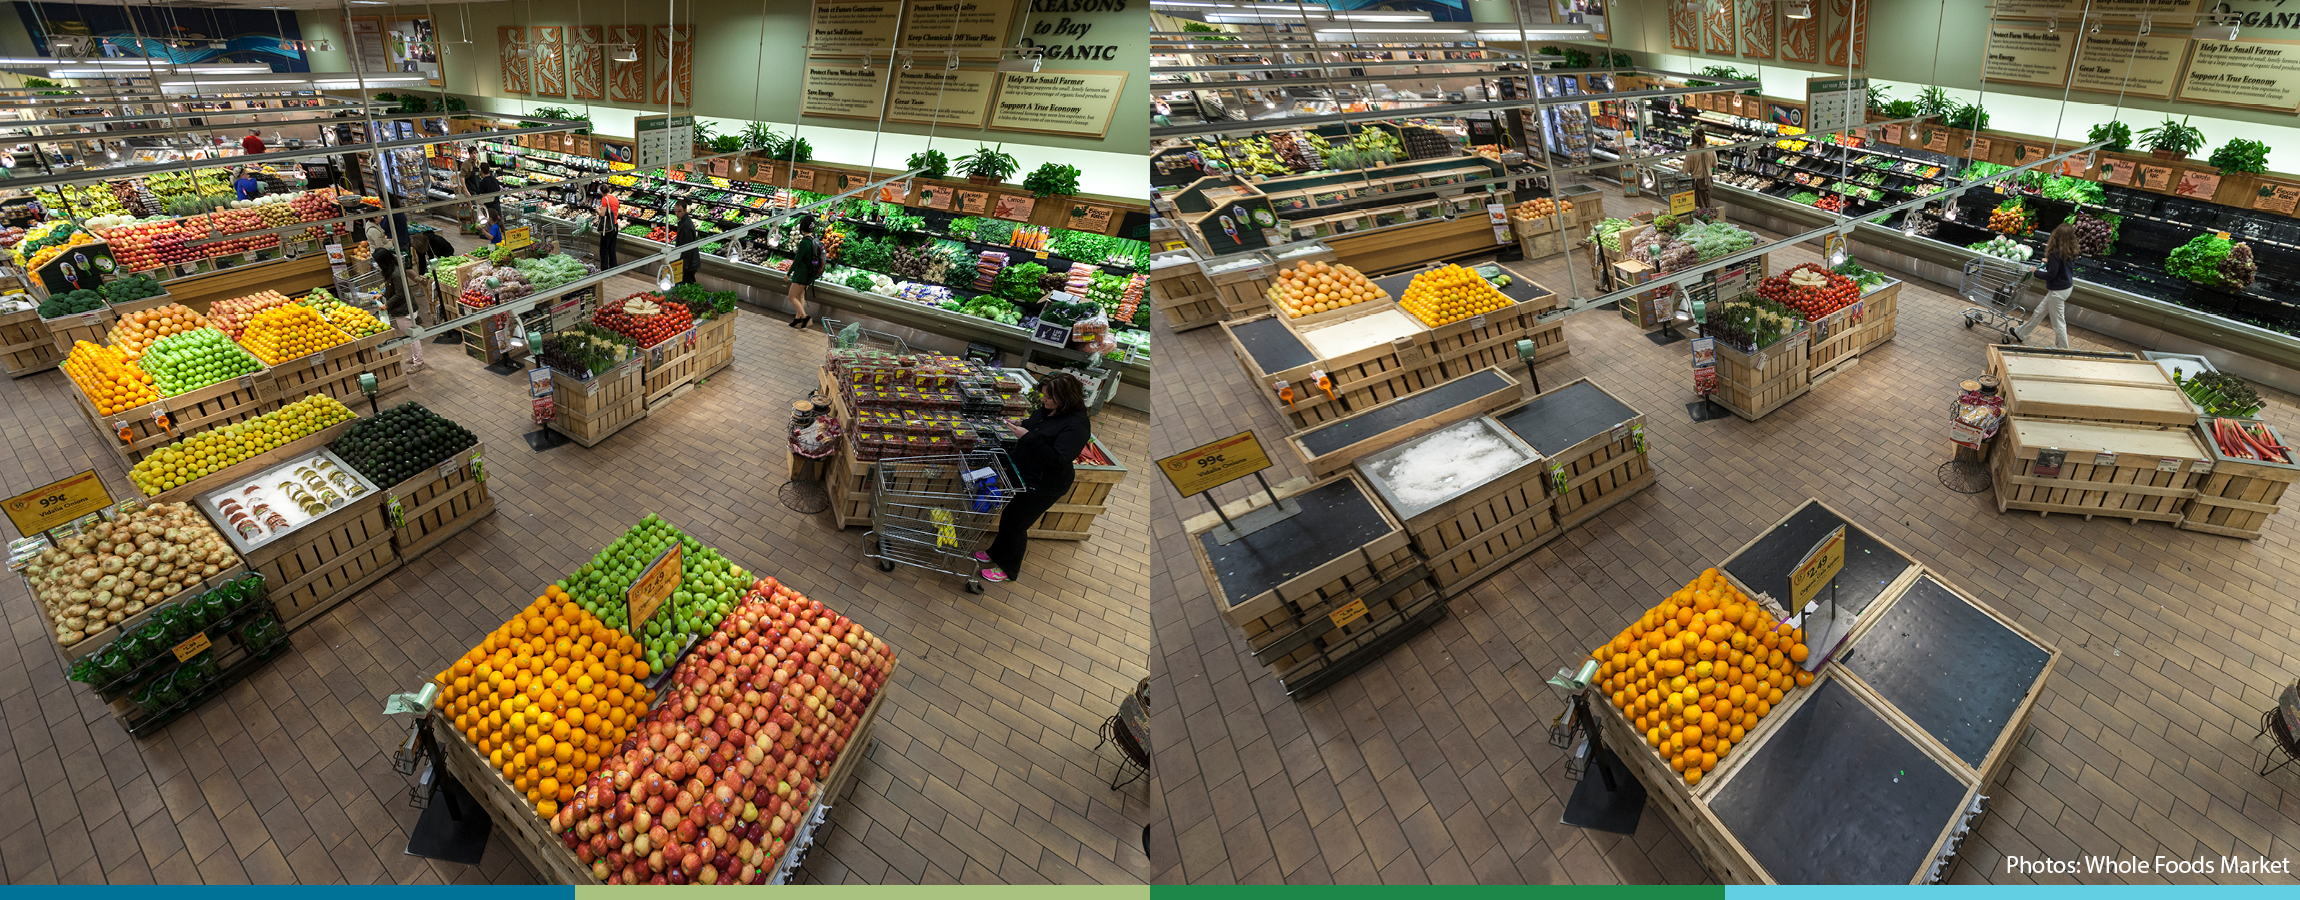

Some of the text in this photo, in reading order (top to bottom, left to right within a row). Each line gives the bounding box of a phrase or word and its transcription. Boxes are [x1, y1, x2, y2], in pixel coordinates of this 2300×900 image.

[2210, 3, 2300, 29] ORGANI
[1034, 18, 1092, 41] to Buy
[2200, 43, 2217, 52] Help
[2219, 44, 2232, 52] The
[2255, 47, 2282, 55] Farmer
[1999, 54, 2015, 62] Energy
[1008, 75, 1024, 84] Help
[2190, 71, 2218, 80] Support
[2226, 74, 2242, 82] True
[2242, 75, 2277, 87] Economy
[1000, 102, 1026, 111] Support
[1050, 104, 1082, 114] Economy
[1718, 280, 1735, 288] Asparagus
[1197, 454, 1226, 468] 99¢
[1197, 458, 1247, 477] Vidalia Onions
[39, 497, 89, 517] Vidalia Onions
[40, 494, 67, 508] 99¢
[1806, 555, 1827, 579] $2.49
[644, 571, 664, 595] $2.49
[1800, 556, 1840, 596] Organic Gala Apples
[638, 596, 654, 612] Organic
